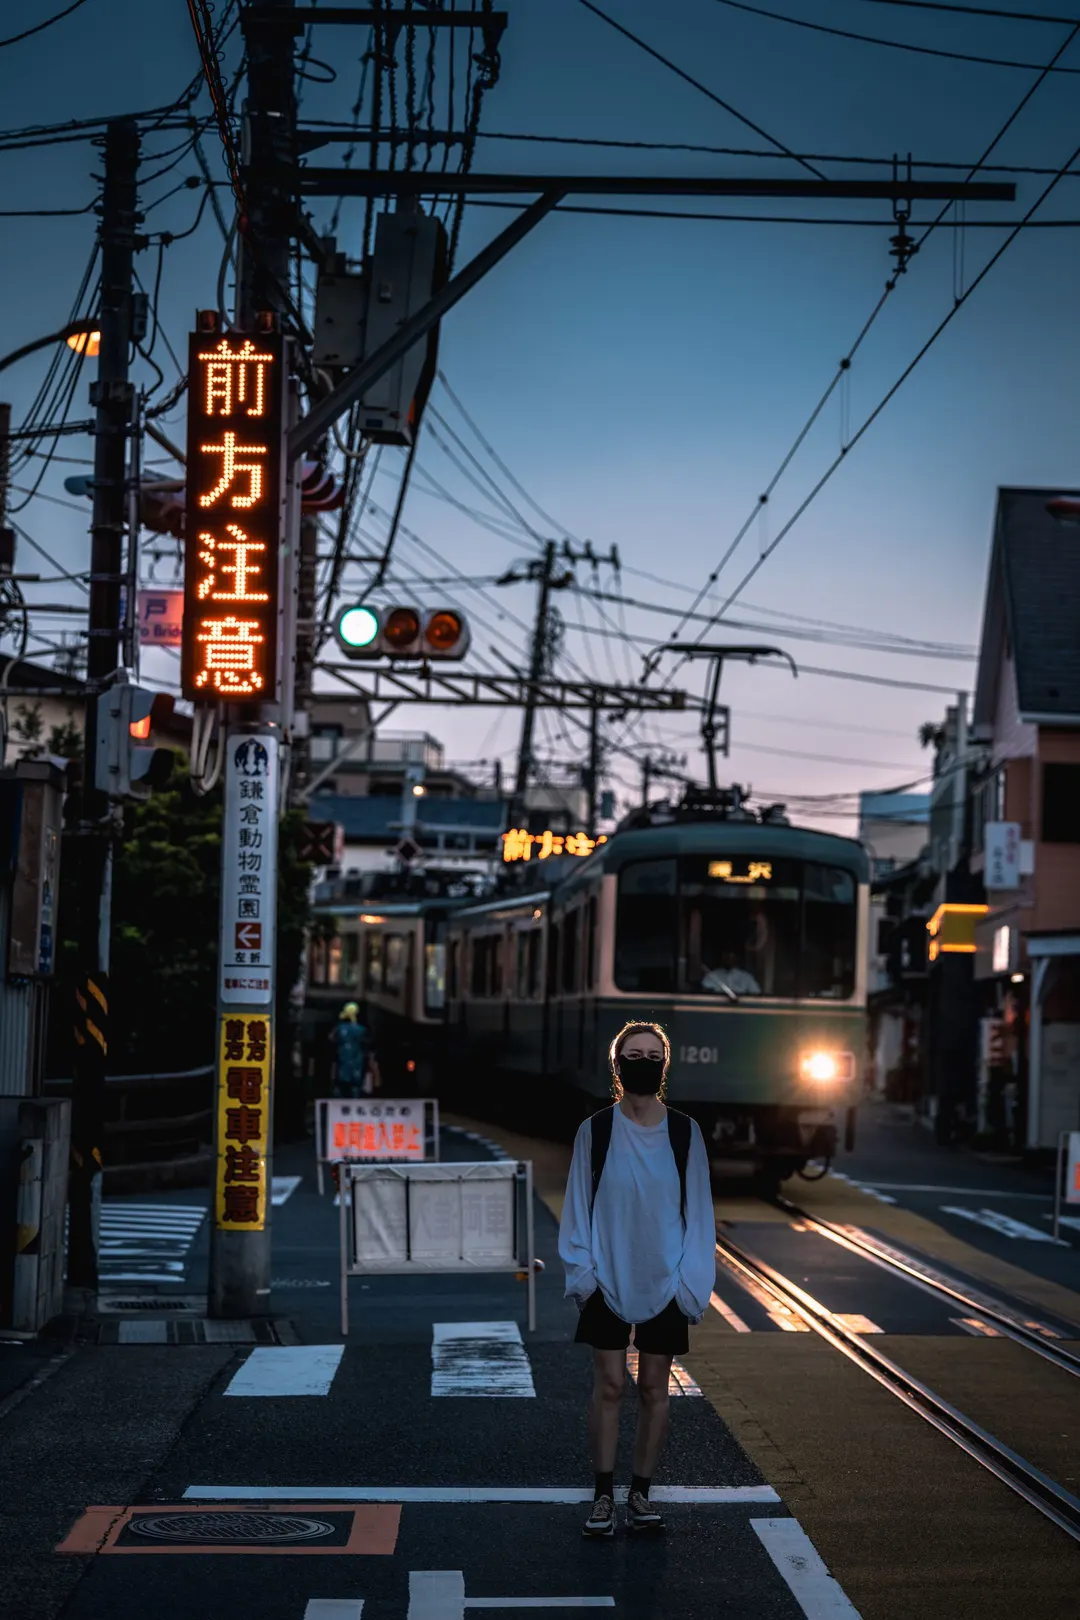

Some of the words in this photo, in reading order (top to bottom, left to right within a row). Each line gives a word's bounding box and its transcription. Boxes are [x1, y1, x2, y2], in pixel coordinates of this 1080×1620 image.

[195, 339, 273, 694] 前方注意
[237, 779, 265, 918] 鎌倉動物霊園
[501, 828, 608, 862] 前方注
[679, 1043, 719, 1063] 1201
[222, 1065, 263, 1223] 電車注意
